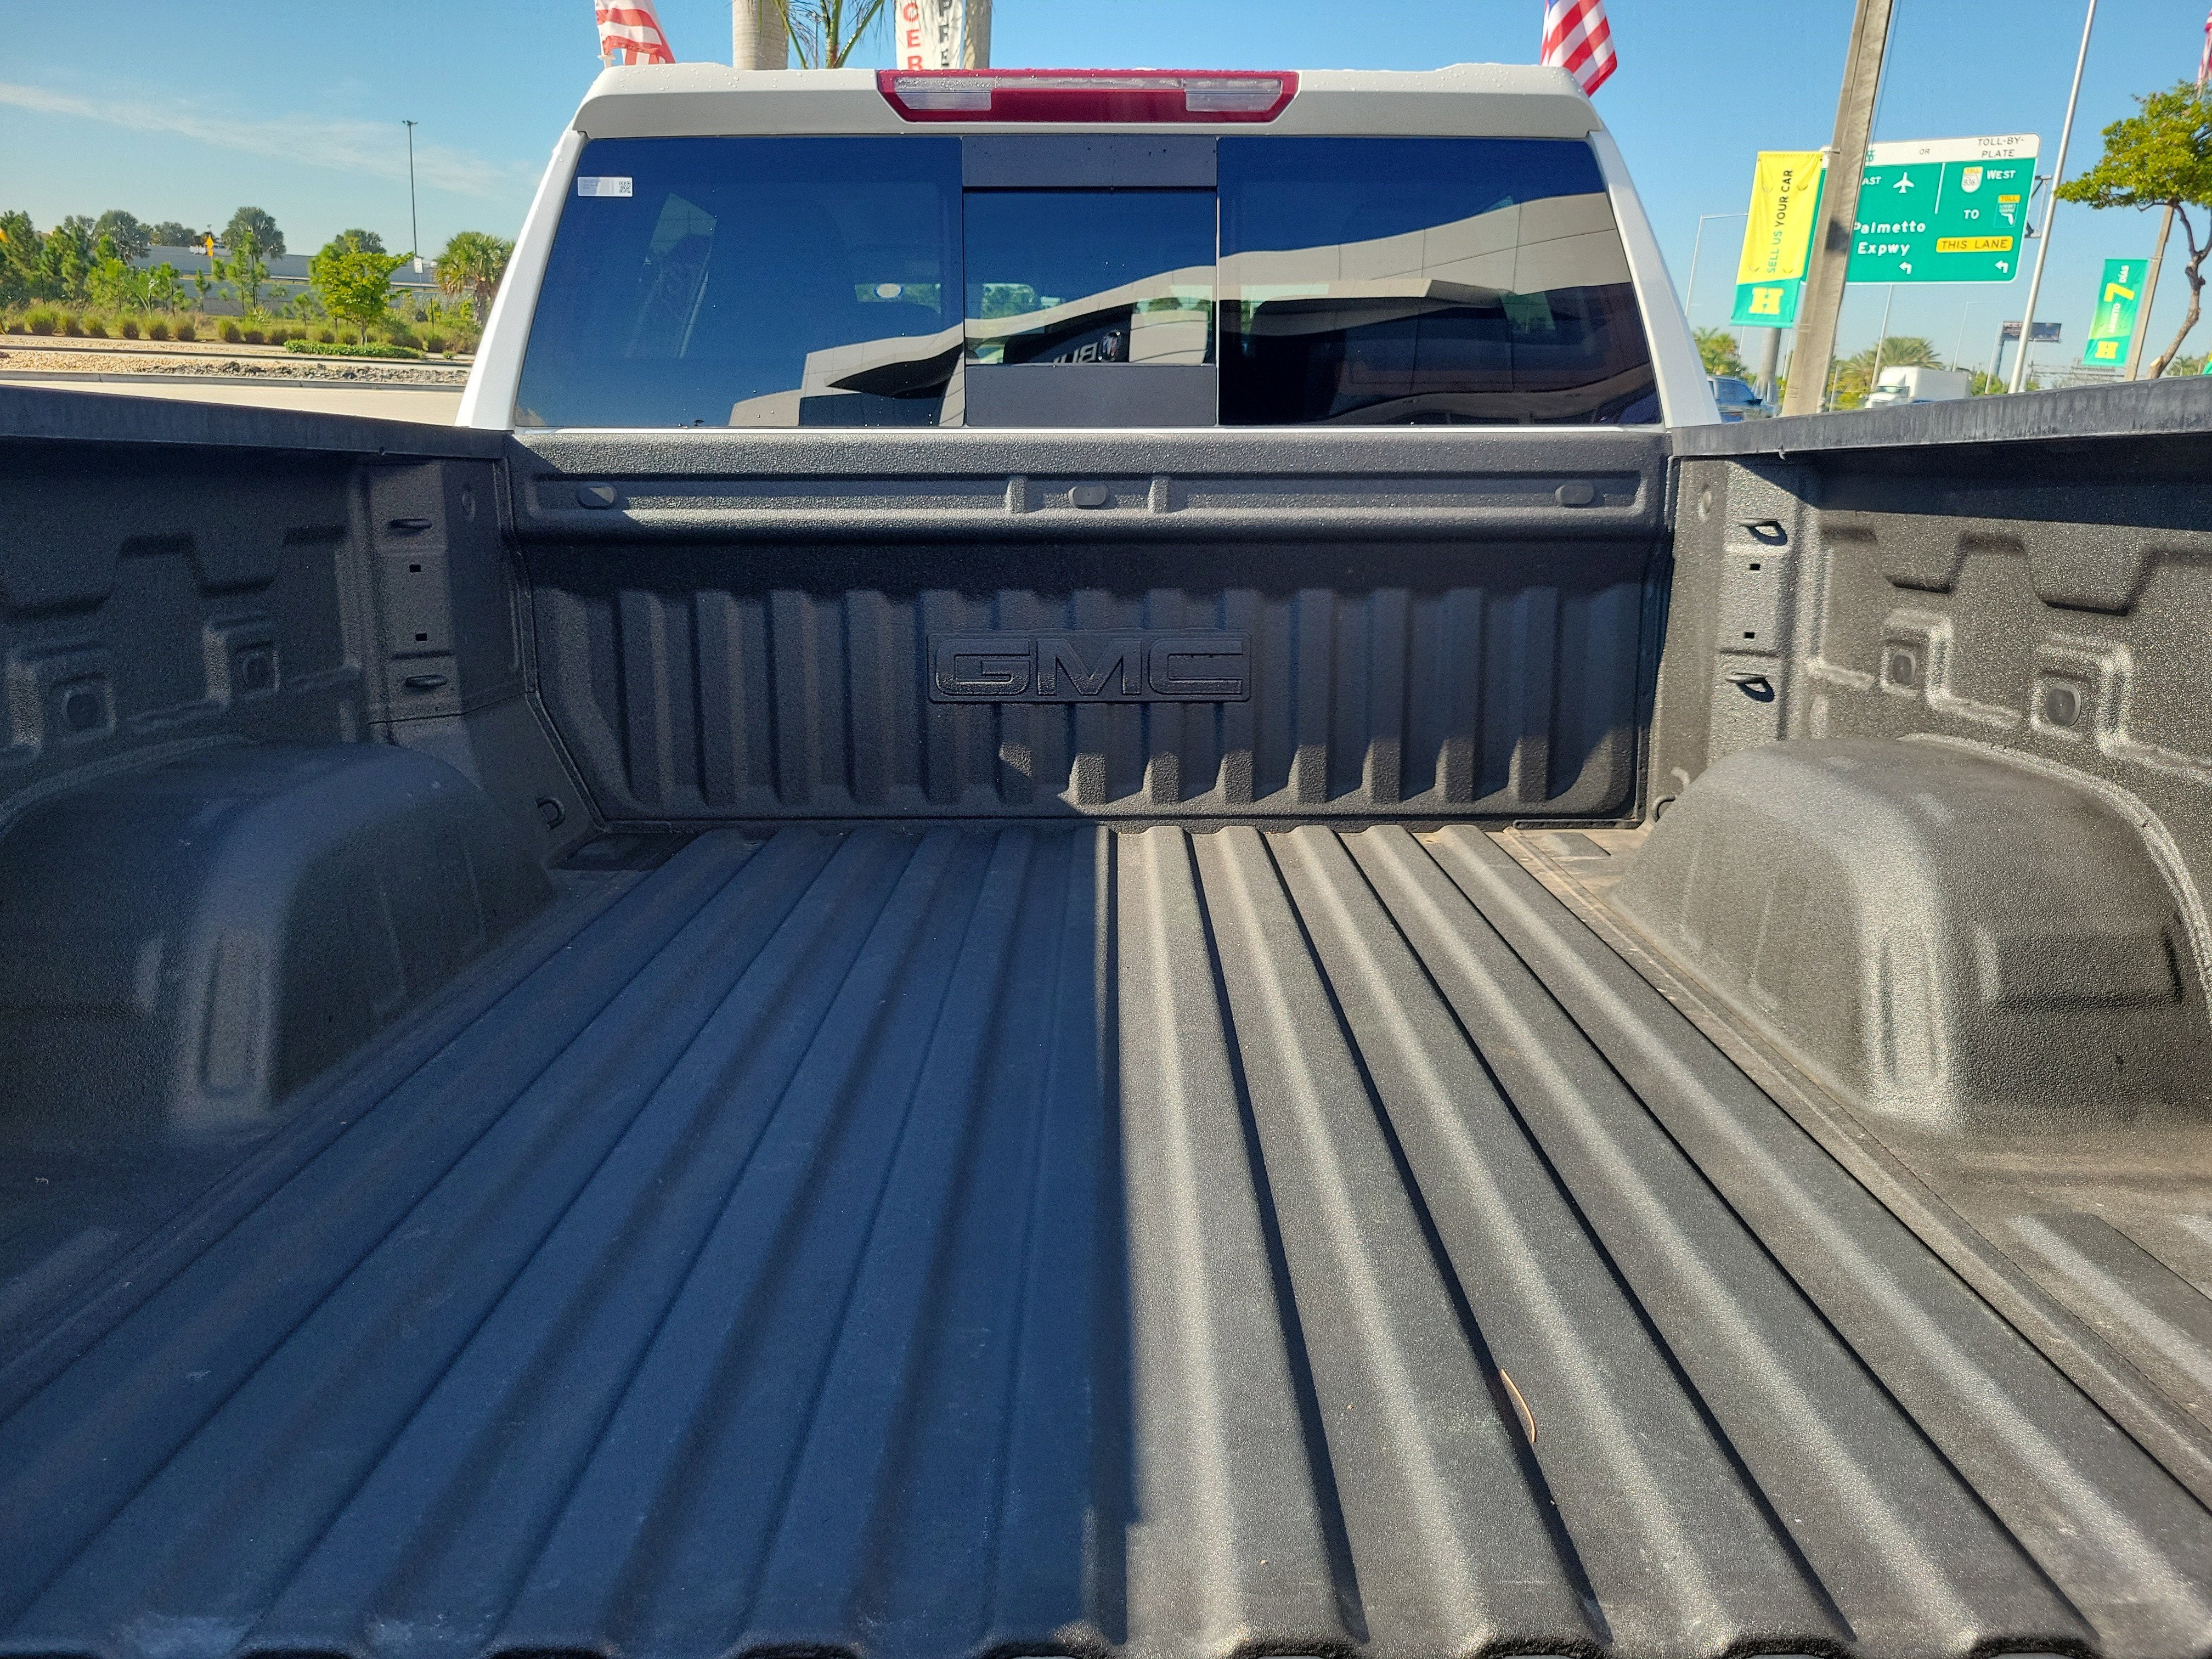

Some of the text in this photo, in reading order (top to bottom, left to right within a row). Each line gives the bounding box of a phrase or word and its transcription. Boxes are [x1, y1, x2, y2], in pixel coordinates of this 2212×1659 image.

[1981, 149, 2016, 158] PLATE
[1861, 176, 1882, 185] AST
[1987, 170, 2016, 180] WEST
[1963, 209, 1980, 219] TO
[1767, 169, 1793, 274] SELL US YOUR CAR
[1858, 241, 1910, 257] Expwy
[1942, 239, 2008, 250] THIS LANE
[2103, 283, 2136, 302] 7
[935, 638, 1244, 696] GMC
